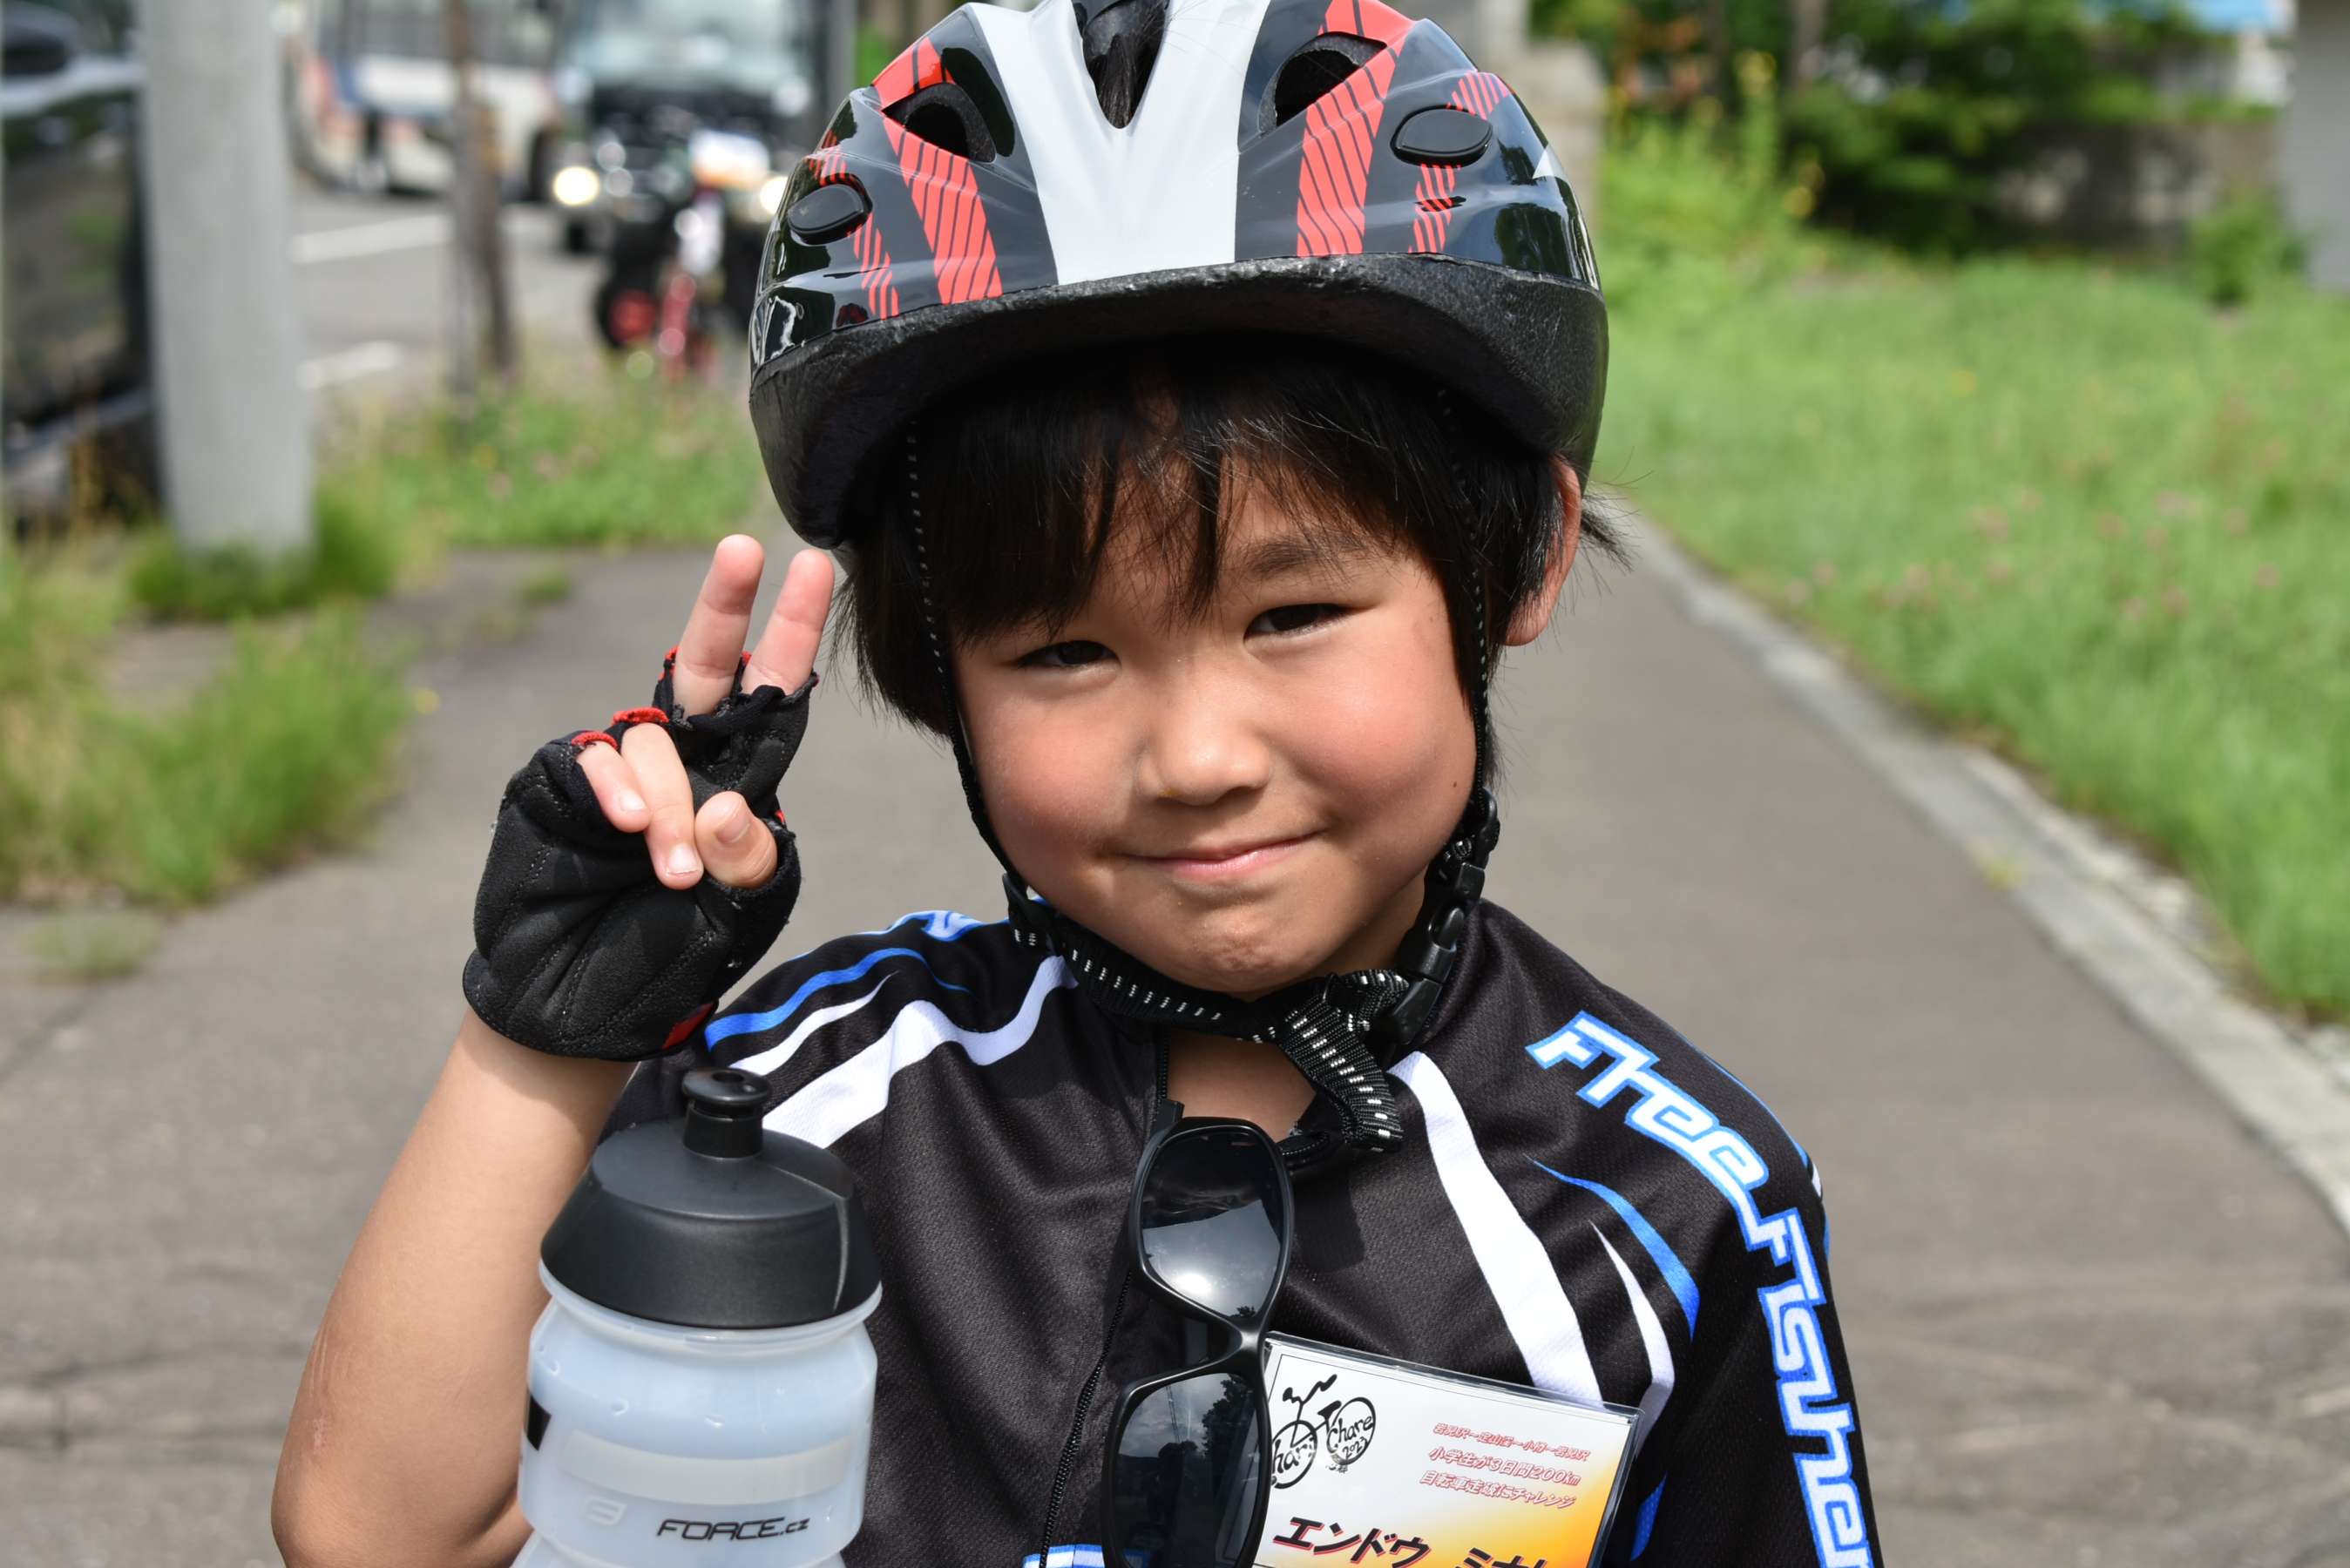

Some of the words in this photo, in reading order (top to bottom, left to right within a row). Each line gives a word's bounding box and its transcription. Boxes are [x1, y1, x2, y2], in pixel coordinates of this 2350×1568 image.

[1525, 1010, 1769, 1220] Free
[1271, 1436, 1316, 1485] hari
[1420, 1470, 1576, 1509] 自転車走破にチャレンジ
[657, 1517, 810, 1541] FORCE.cz
[1273, 1517, 1432, 1568] エンドウ
